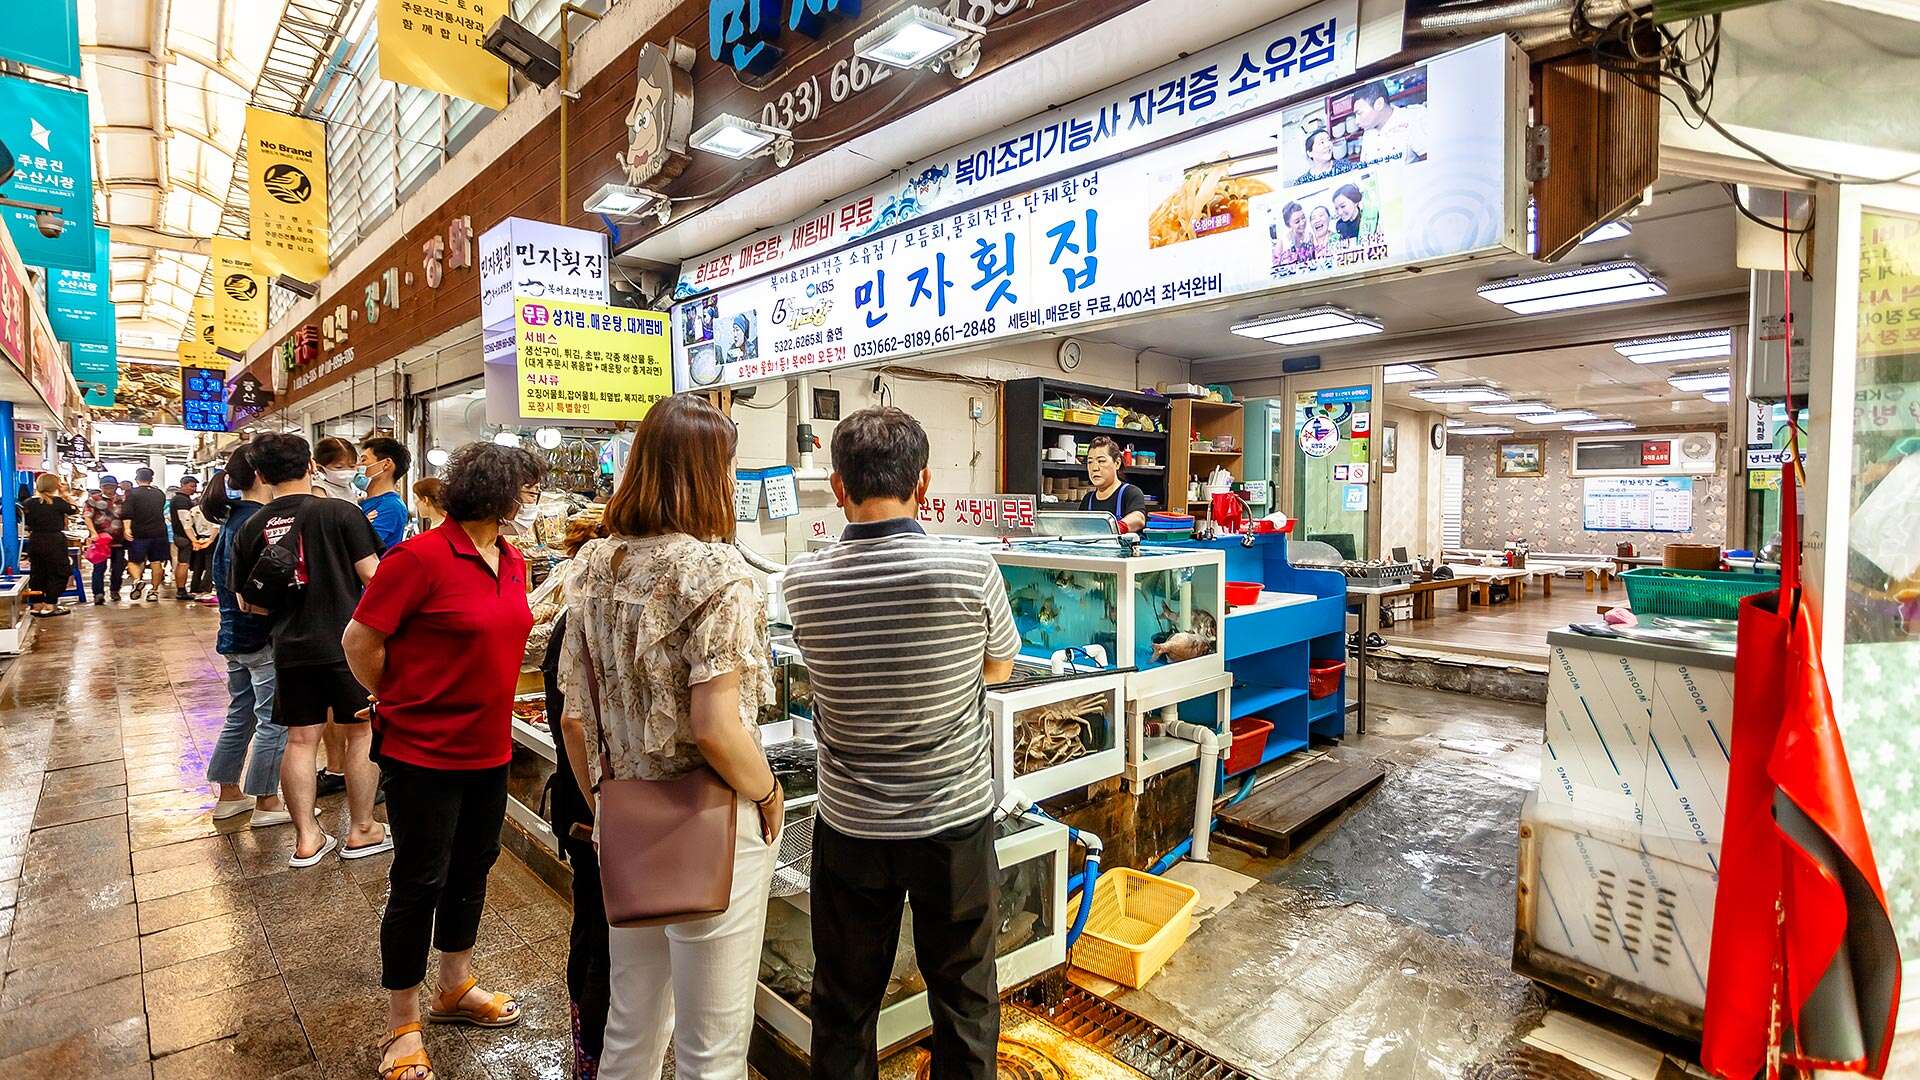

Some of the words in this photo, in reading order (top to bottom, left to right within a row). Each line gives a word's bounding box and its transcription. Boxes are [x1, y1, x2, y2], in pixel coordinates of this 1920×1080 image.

[401, 1, 485, 33] 주문진전통시장과
[955, 102, 1122, 187] 복어조리기능사
[1128, 64, 1219, 132] 자격증
[1228, 17, 1338, 99] 소유점
[260, 139, 277, 151] No
[278, 144, 313, 158] Brand
[17, 153, 64, 174] 주문진
[13, 167, 76, 191] 수산시장
[694, 254, 735, 285] 회포장,
[739, 234, 785, 270] 매운탕,
[789, 211, 835, 251] 세팅비
[839, 196, 875, 232] 무료
[848, 239, 884, 267] 소유점
[515, 242, 603, 280] 민자횟집
[815, 278, 835, 296] KBS
[1161, 272, 1222, 300] 좌석완비
[523, 304, 548, 325] 무료
[524, 331, 558, 345] 서비스
[853, 317, 996, 359] 033)662-8189,661-2848
[524, 345, 562, 359] 생선구이,
[564, 349, 583, 361] 튀김,
[585, 350, 603, 362] 초밥,
[605, 351, 621, 363] 각종
[524, 357, 544, 369] (대게
[546, 358, 569, 371] 주문시
[600, 363, 622, 375] 매운탕
[526, 373, 560, 386] 식사류
[527, 401, 554, 413] 포장시
[556, 402, 590, 414] 특별할인
[915, 497, 947, 523] 운탕
[954, 498, 999, 528] 셋팅비
[1001, 498, 1037, 529] 무료
[1555, 647, 1581, 691] WOOSUNG
[1619, 657, 1648, 704] WOOSUNG
[1678, 664, 1708, 713] WOOSUNG
[1680, 796, 1709, 846] WOOSUNG
